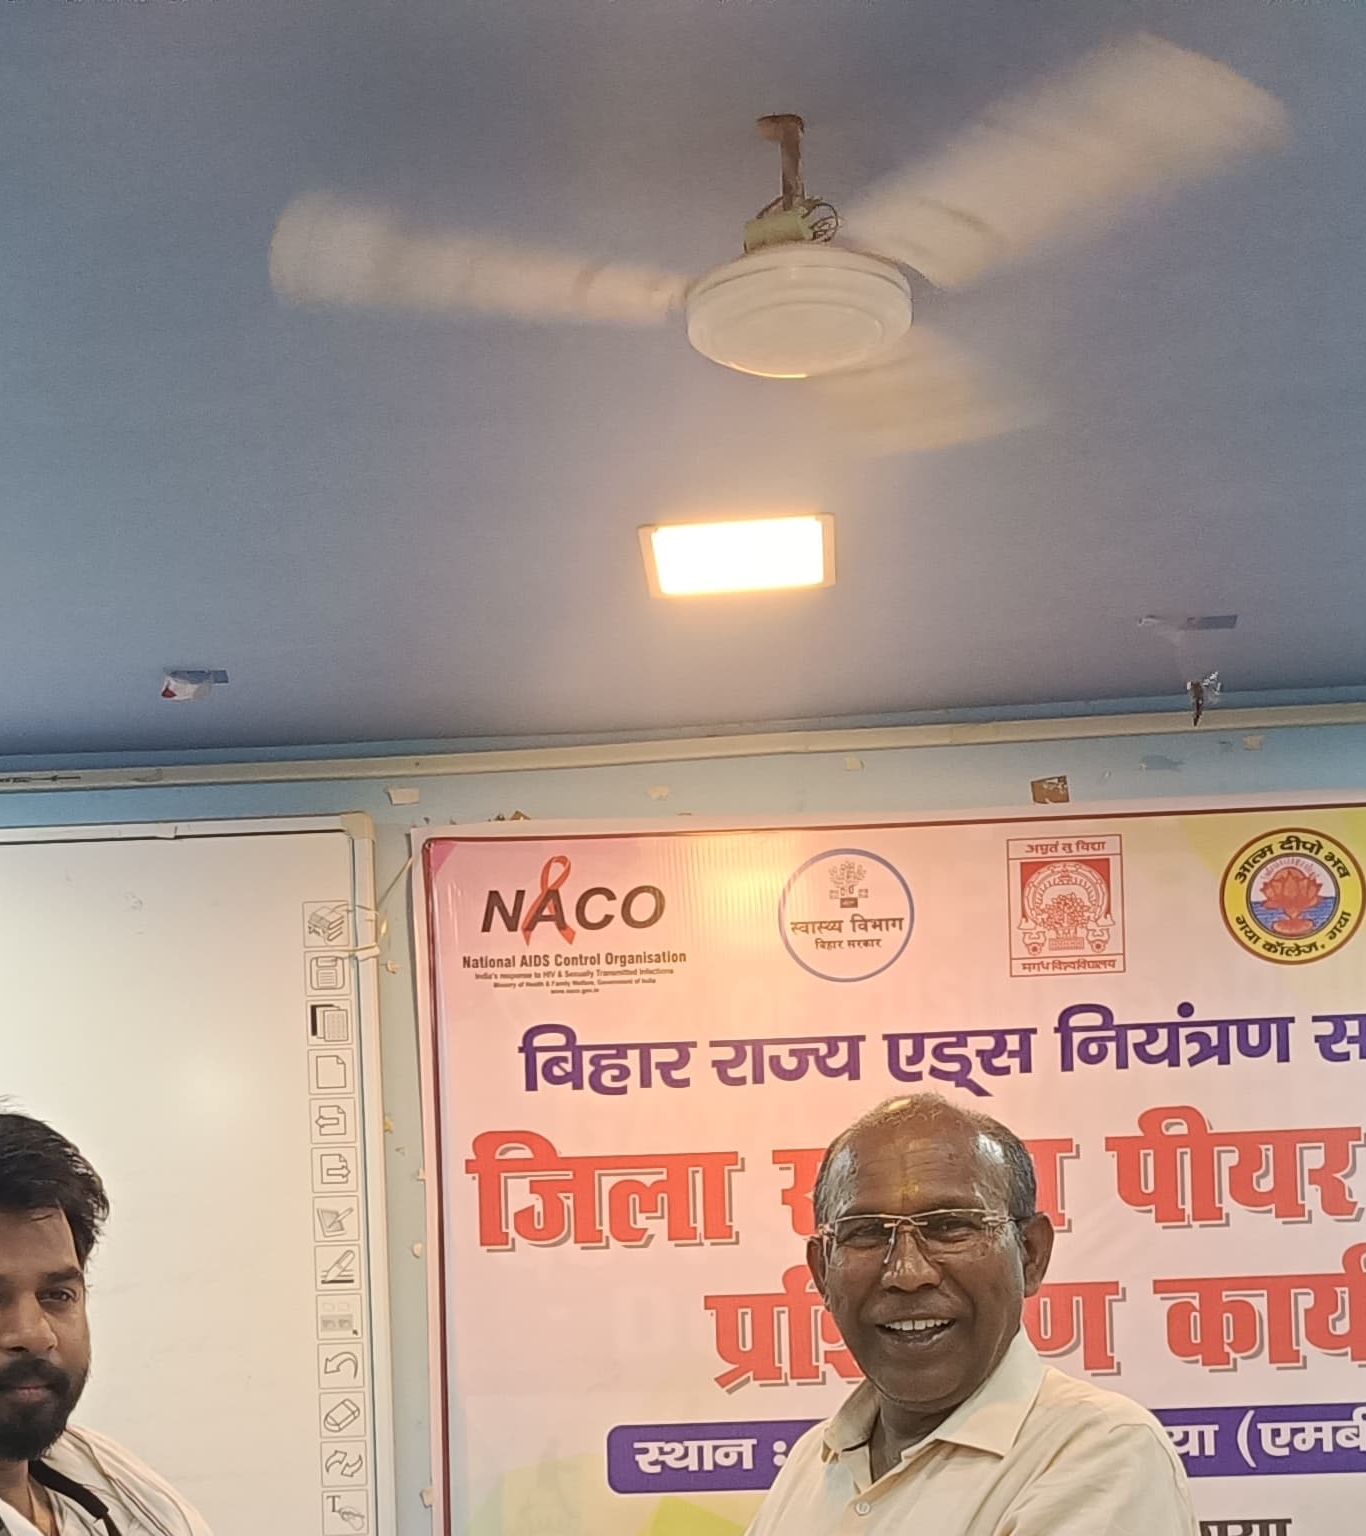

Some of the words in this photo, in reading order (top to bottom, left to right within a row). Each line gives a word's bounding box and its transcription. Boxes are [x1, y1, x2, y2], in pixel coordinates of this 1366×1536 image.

[1324, 851, 1351, 879] भव
[481, 884, 666, 933] NACO
[850, 913, 905, 933] विभाग
[1235, 914, 1261, 944] गया
[1326, 911, 1351, 940] गया
[462, 955, 515, 968] National
[520, 954, 550, 967] AIDS
[555, 952, 601, 967] Control
[605, 950, 687, 967] Organisation
[517, 1023, 698, 1095] बिहार
[710, 1033, 866, 1088] राज्य
[882, 1027, 1037, 1097] एड्स
[1054, 1001, 1295, 1073] नियंत्रण
[465, 1130, 743, 1251] जिला
[1105, 1105, 1366, 1227] पीयर
[633, 1438, 757, 1474] स्थान
